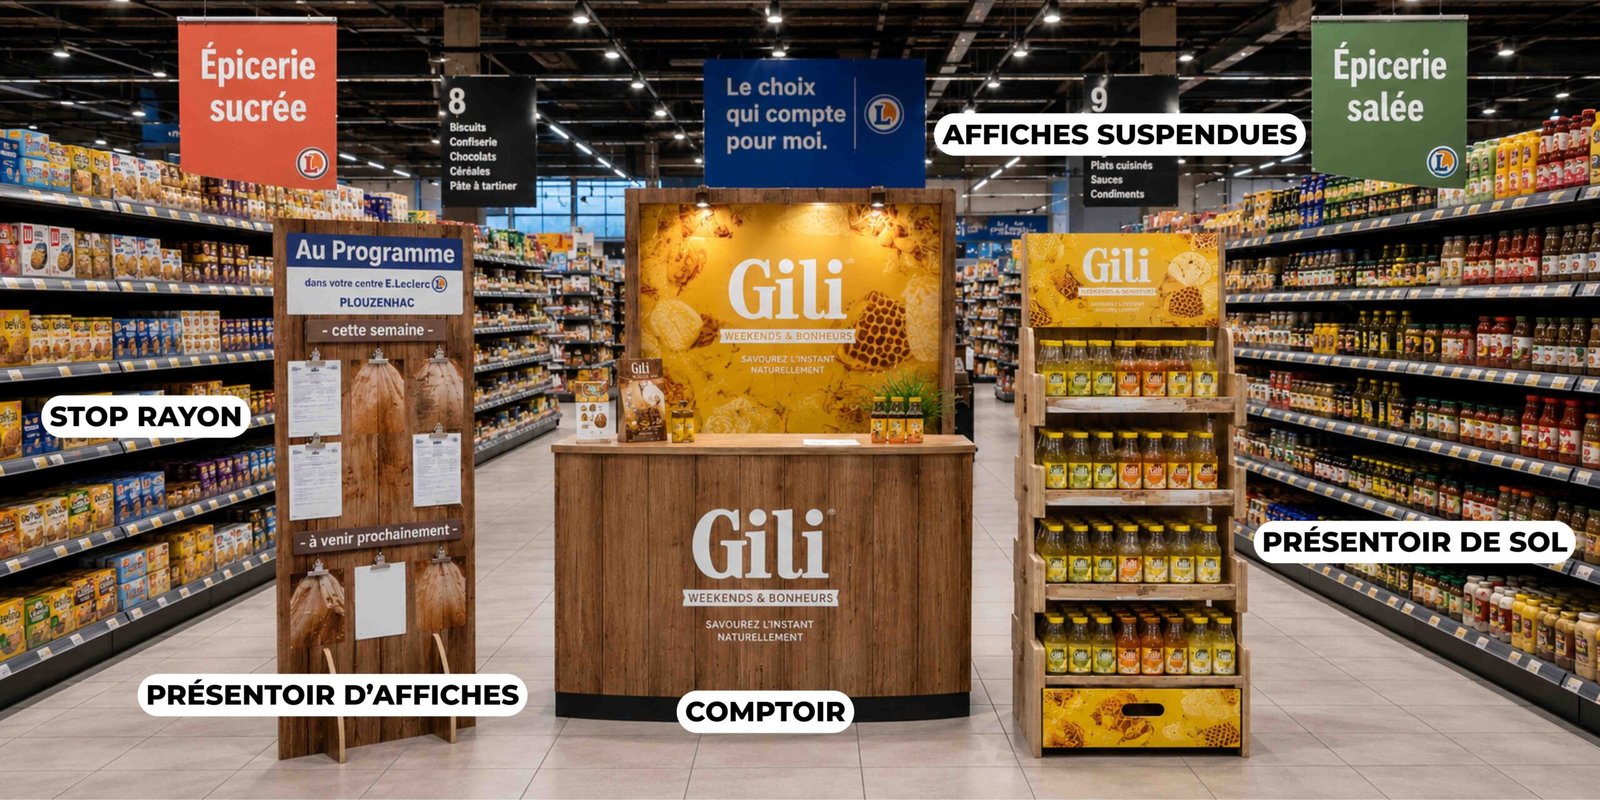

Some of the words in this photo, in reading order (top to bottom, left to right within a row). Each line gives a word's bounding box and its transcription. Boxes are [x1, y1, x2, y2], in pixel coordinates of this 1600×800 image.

[202, 41, 316, 88] Épicerie
[1334, 41, 1447, 88] Épicerie
[727, 78, 752, 96] Le
[758, 77, 816, 96] choix
[448, 87, 466, 115] 8
[1090, 87, 1108, 112] 9
[210, 90, 307, 122] sucrée
[1347, 90, 1424, 122] salée
[726, 104, 759, 127] qui
[765, 106, 847, 127] compte
[450, 122, 487, 132] Biscuits
[450, 136, 498, 147] Confiserie
[727, 134, 777, 155] pour
[782, 131, 828, 150] moi.
[450, 151, 497, 161] Chocolats
[450, 165, 491, 176] Céréales
[1090, 160, 1115, 170] Plats
[1116, 160, 1154, 170] cuisinés
[1090, 174, 1124, 185] Sauces
[450, 180, 472, 191] Pâte
[473, 180, 480, 191] à
[481, 181, 518, 191] tartiner
[1090, 189, 1145, 199] Condiments
[296, 239, 325, 260] Au
[332, 240, 455, 266] Programme
[1082, 247, 1151, 283] Gili
[304, 278, 328, 288] dans
[329, 280, 353, 288] votre
[354, 280, 384, 288] centre
[385, 279, 430, 289] E.Leclerc
[728, 258, 847, 320] Gili
[339, 297, 415, 308] PLOUZENHAC
[331, 325, 367, 337] cette
[370, 323, 425, 337] semaine
[724, 331, 782, 341] WEEKENDS
[785, 331, 793, 341] &
[795, 331, 853, 341] BONHEURS
[741, 355, 788, 364] SAVOUREZ
[790, 355, 835, 364] L'INSTANT
[750, 366, 825, 374] NATURELLEMENT
[309, 536, 317, 548] à
[320, 532, 355, 547] venir
[357, 525, 450, 547] prochainement
[692, 508, 830, 580] Gili
[687, 593, 754, 603] WEEKENDS
[756, 593, 765, 603] &
[768, 593, 834, 603] BONHEURS
[705, 620, 760, 629] SAVOUREZ
[762, 620, 815, 629] L'INSTANT
[717, 632, 804, 642] NATURELLEMENT
